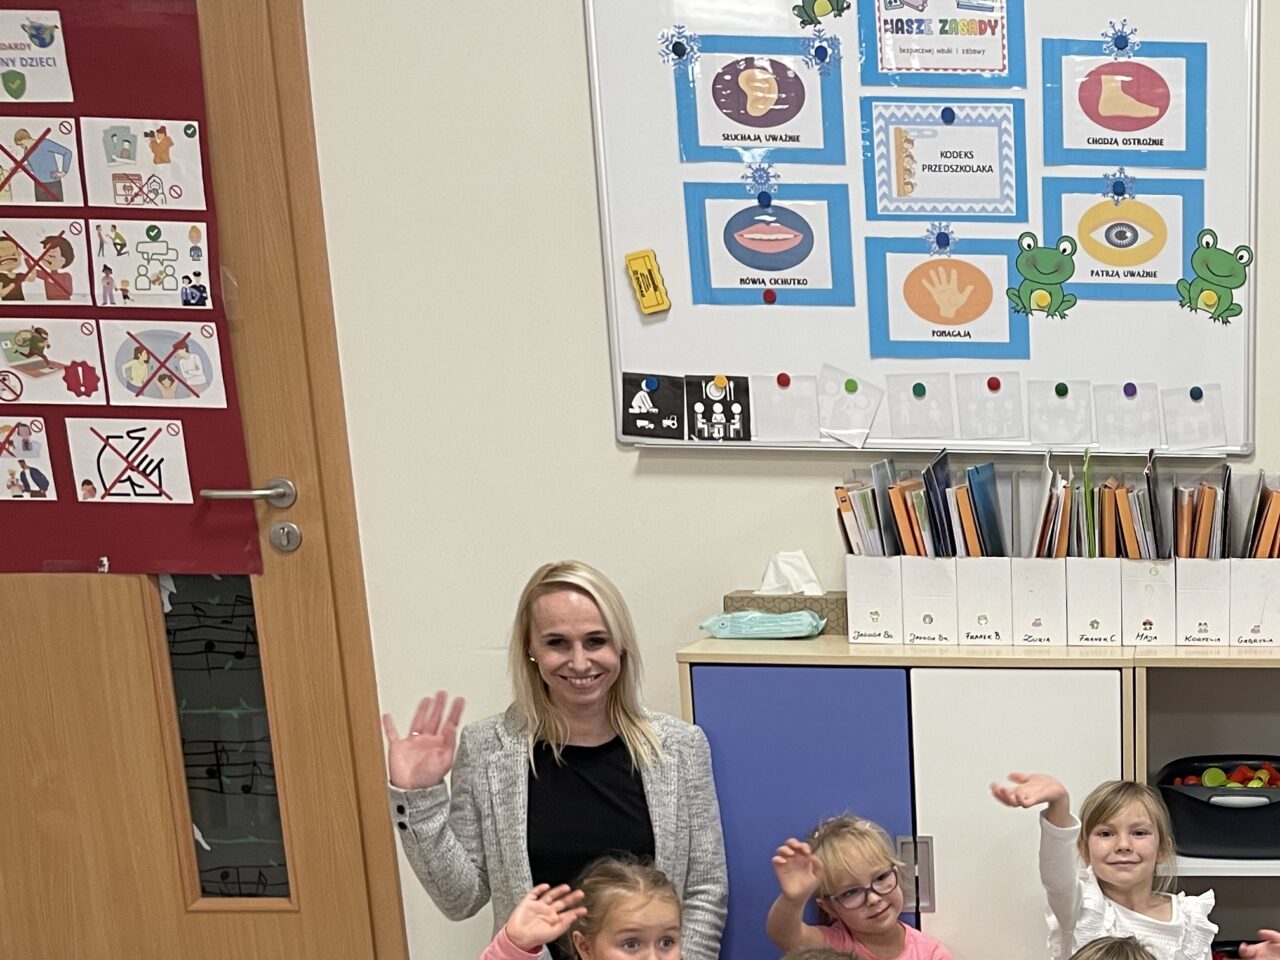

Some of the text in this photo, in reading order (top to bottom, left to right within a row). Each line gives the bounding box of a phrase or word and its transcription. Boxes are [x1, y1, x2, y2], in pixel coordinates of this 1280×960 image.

[883, 18, 999, 36] NASZE ZASADY
[20, 56, 57, 67] DZIECI
[722, 133, 801, 143] SŁUCHAJĄ UWAŻNIE
[1086, 137, 1164, 147] CHODZĄ OSTROŻNIE
[940, 150, 974, 159] KODEKS
[922, 164, 994, 173] PRZEDSZKOLAKA
[1090, 269, 1158, 279] PATRZĄ UWAŻNIE
[739, 277, 809, 287] MÓWIĄ CICHUTKO
[931, 329, 972, 339] POMAGAJĄ
[1135, 633, 1158, 643] MAJA
